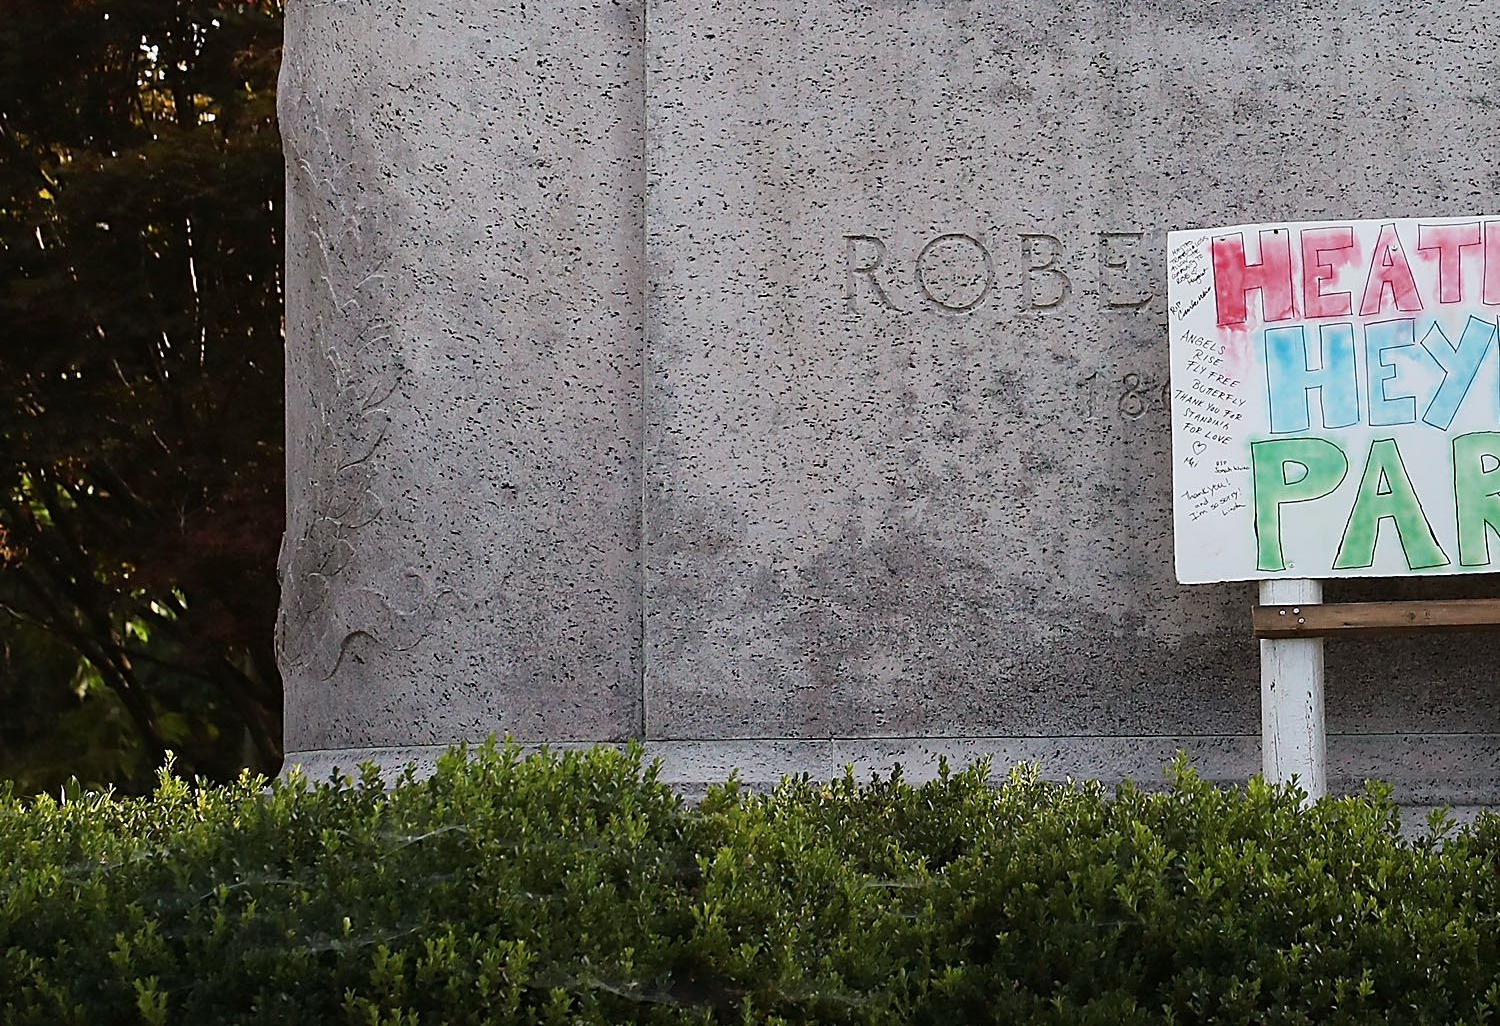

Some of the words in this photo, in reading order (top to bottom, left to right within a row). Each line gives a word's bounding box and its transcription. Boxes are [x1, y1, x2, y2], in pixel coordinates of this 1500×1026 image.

[843, 231, 1154, 316] ROBE
[1180, 329, 1226, 356] ANGELS
[1192, 348, 1224, 367] RISE
[1186, 360, 1207, 375] FLY
[1207, 370, 1240, 388] FREE
[1174, 389, 1205, 408] THANK
[1206, 402, 1220, 414] YOU
[1223, 409, 1243, 422] FOR
[1192, 378, 1247, 407] BUTTERFLY
[1183, 407, 1230, 431] STANDING
[1182, 422, 1203, 435] FOR
[1204, 430, 1233, 445] LOVE
[1194, 496, 1209, 509] and
